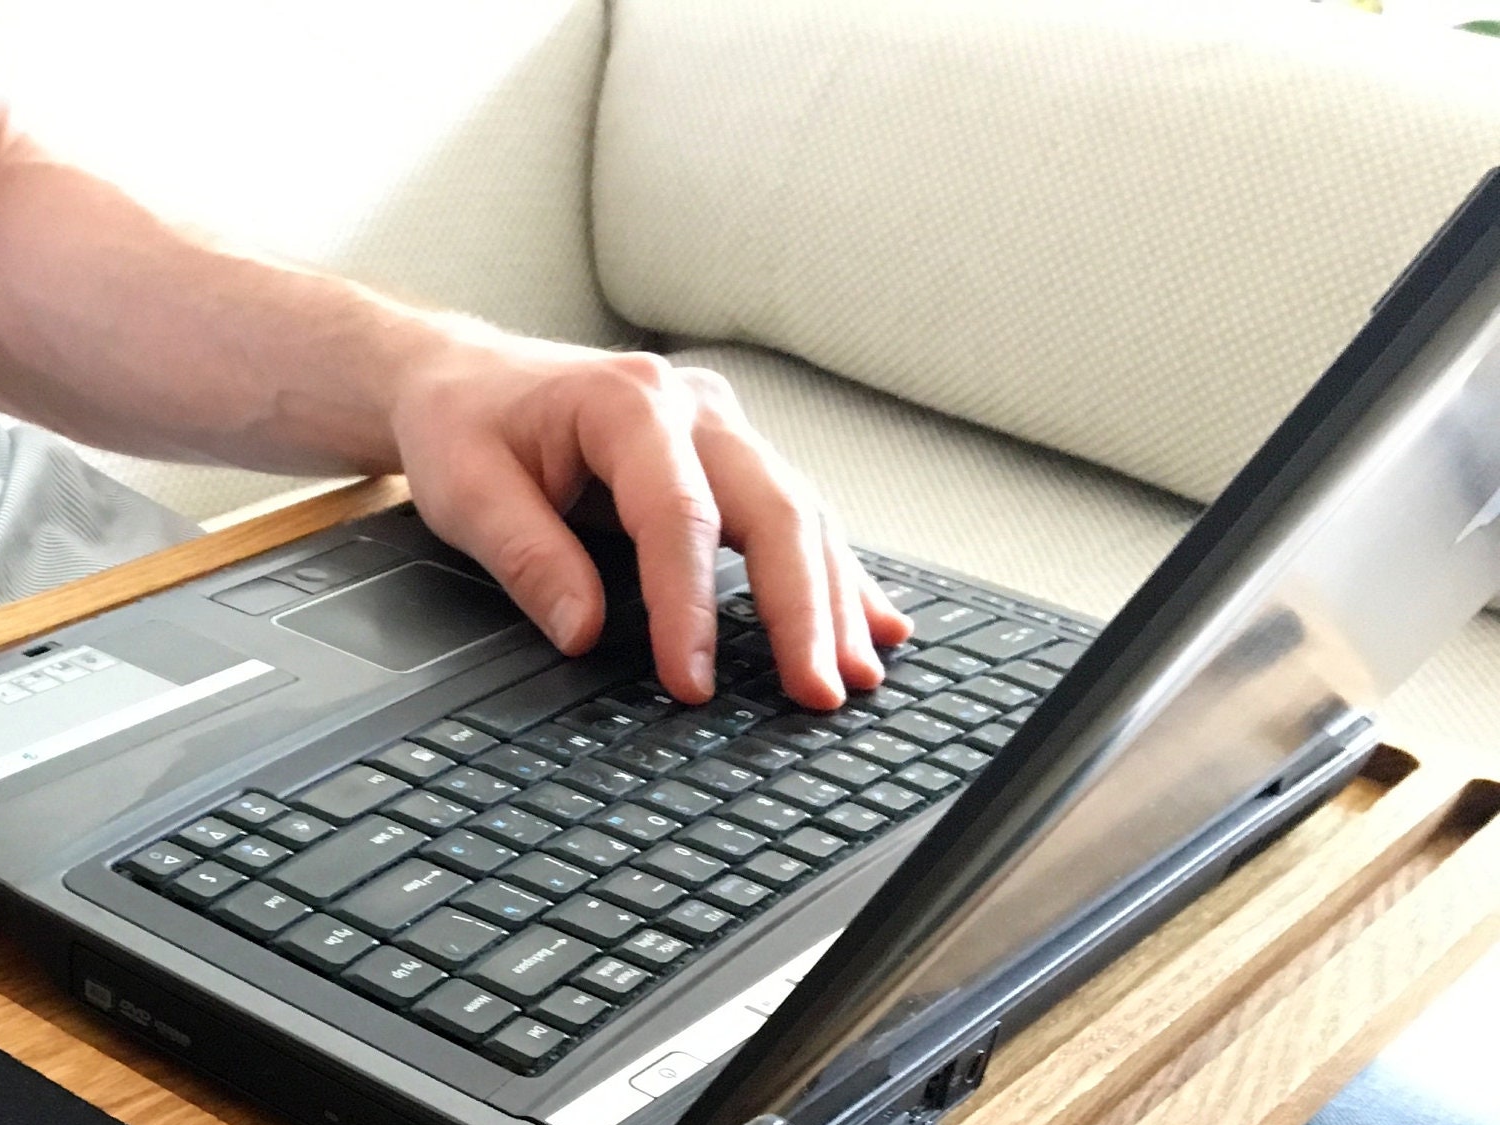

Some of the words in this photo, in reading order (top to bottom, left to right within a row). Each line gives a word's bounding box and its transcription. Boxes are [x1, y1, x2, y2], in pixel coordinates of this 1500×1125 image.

[612, 715, 632, 724] N
[696, 729, 716, 738] H
[568, 736, 592, 746] M
[771, 748, 791, 758] Y
[614, 772, 634, 782] K
[730, 770, 750, 780] U
[572, 794, 592, 804] L
[648, 816, 668, 826] O
[716, 822, 734, 831] 9
[608, 840, 628, 850] P
[264, 895, 286, 908] End
[512, 948, 556, 974] Backspace
[463, 994, 492, 1012] Home
[526, 1026, 549, 1039] Del
